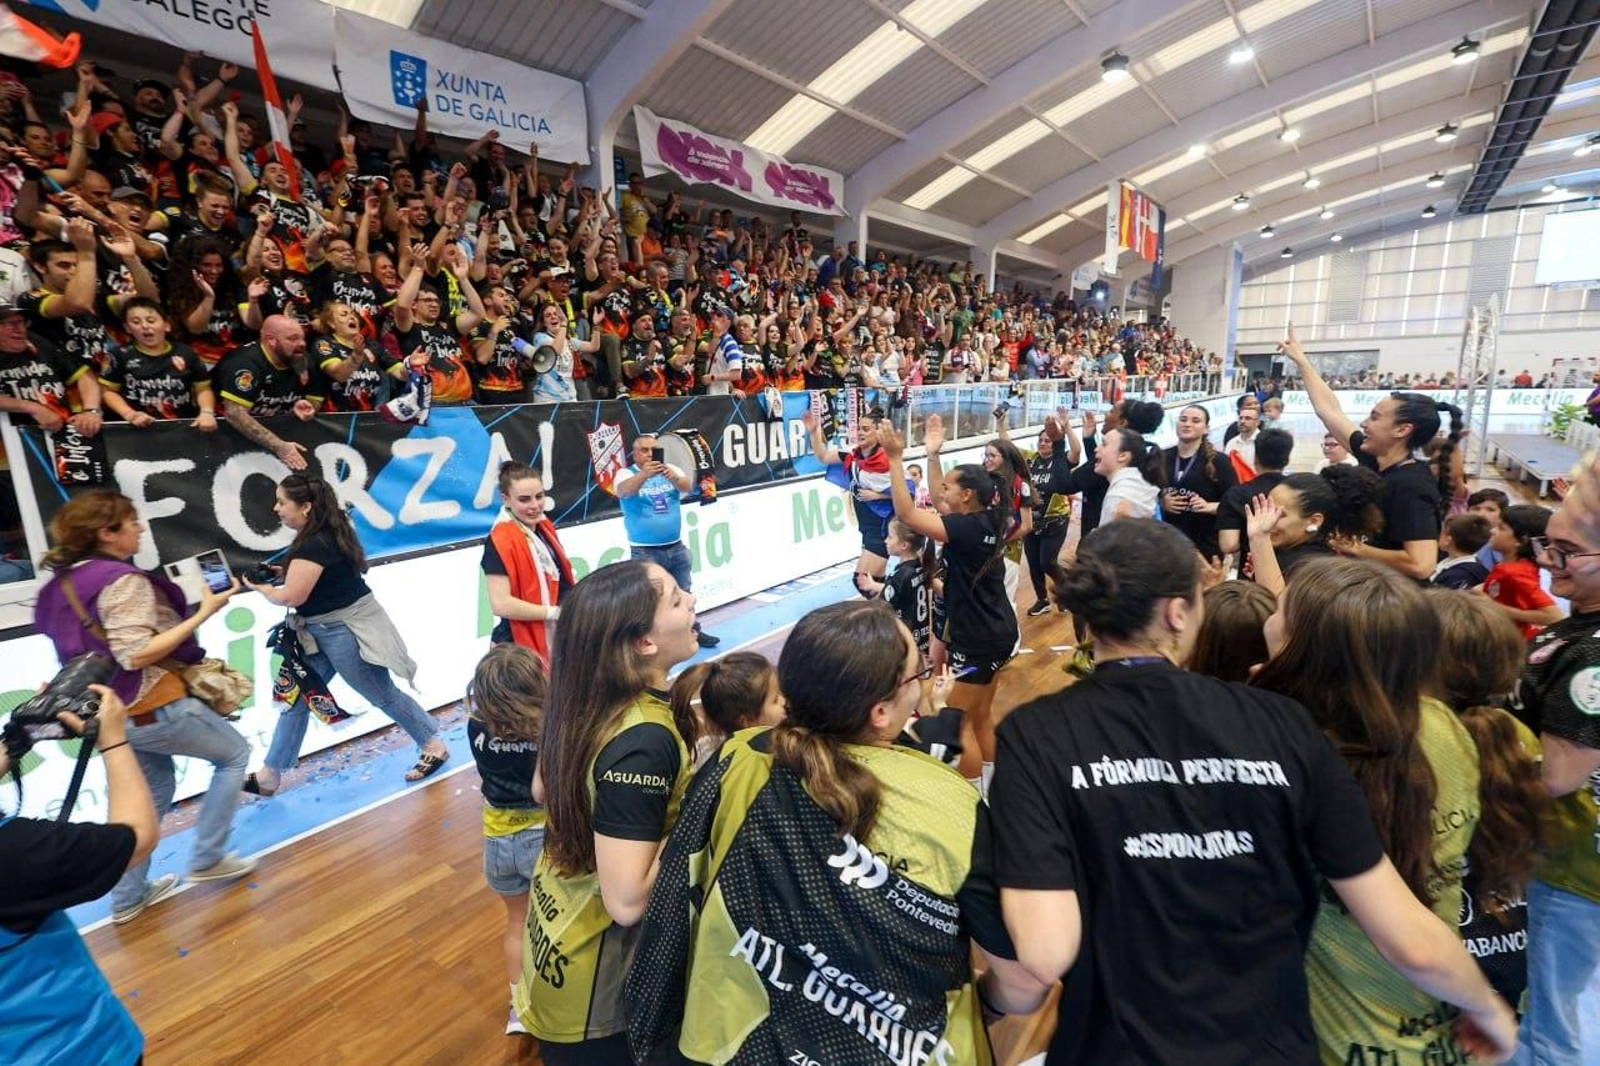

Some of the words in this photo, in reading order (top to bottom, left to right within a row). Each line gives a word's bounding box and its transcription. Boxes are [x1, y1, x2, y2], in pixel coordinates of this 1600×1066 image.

[436, 69, 506, 104] XUNTA
[436, 95, 464, 116] DE
[469, 103, 551, 134] GALICIA
[917, 585, 928, 622] 8
[600, 769, 667, 788] AGUARDA
[1071, 765, 1089, 789] A
[1180, 758, 1290, 787] PERFECTA
[729, 927, 793, 993] ATL.
[799, 942, 907, 1022] Mecalia
